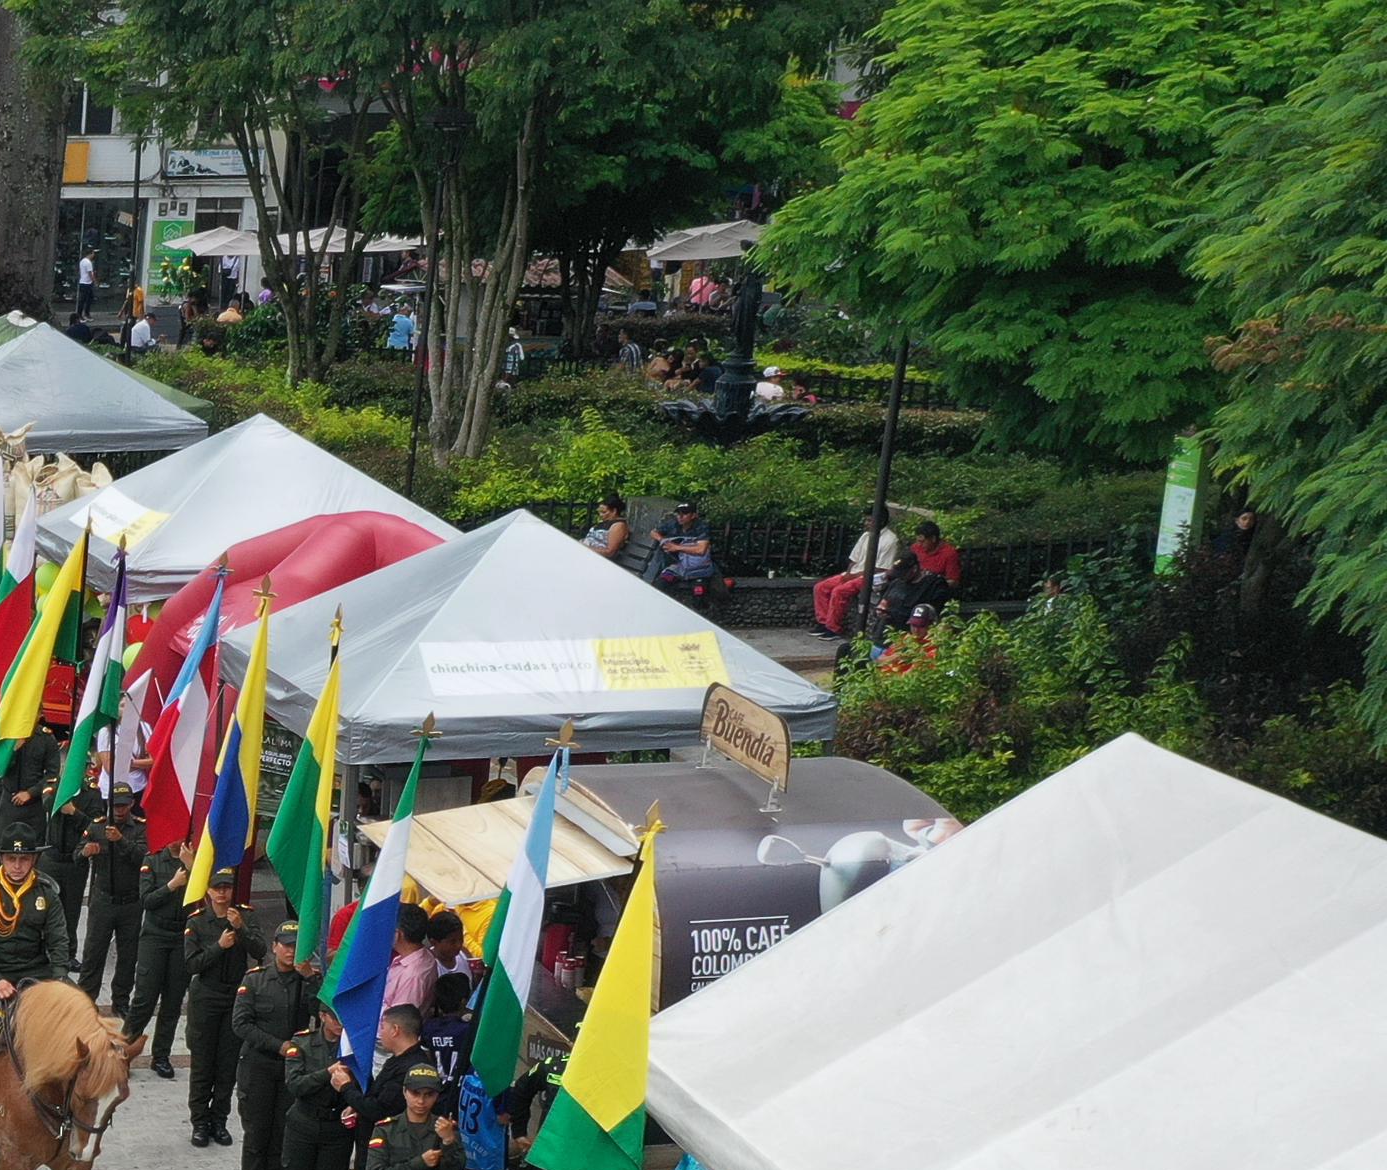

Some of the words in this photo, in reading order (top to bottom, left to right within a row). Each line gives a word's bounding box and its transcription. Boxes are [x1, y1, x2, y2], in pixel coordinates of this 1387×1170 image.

[713, 698, 775, 768] Buendía
[691, 927, 742, 954] 100%
[746, 918, 790, 951] CAFÉ
[432, 1036, 454, 1047] FELIPE
